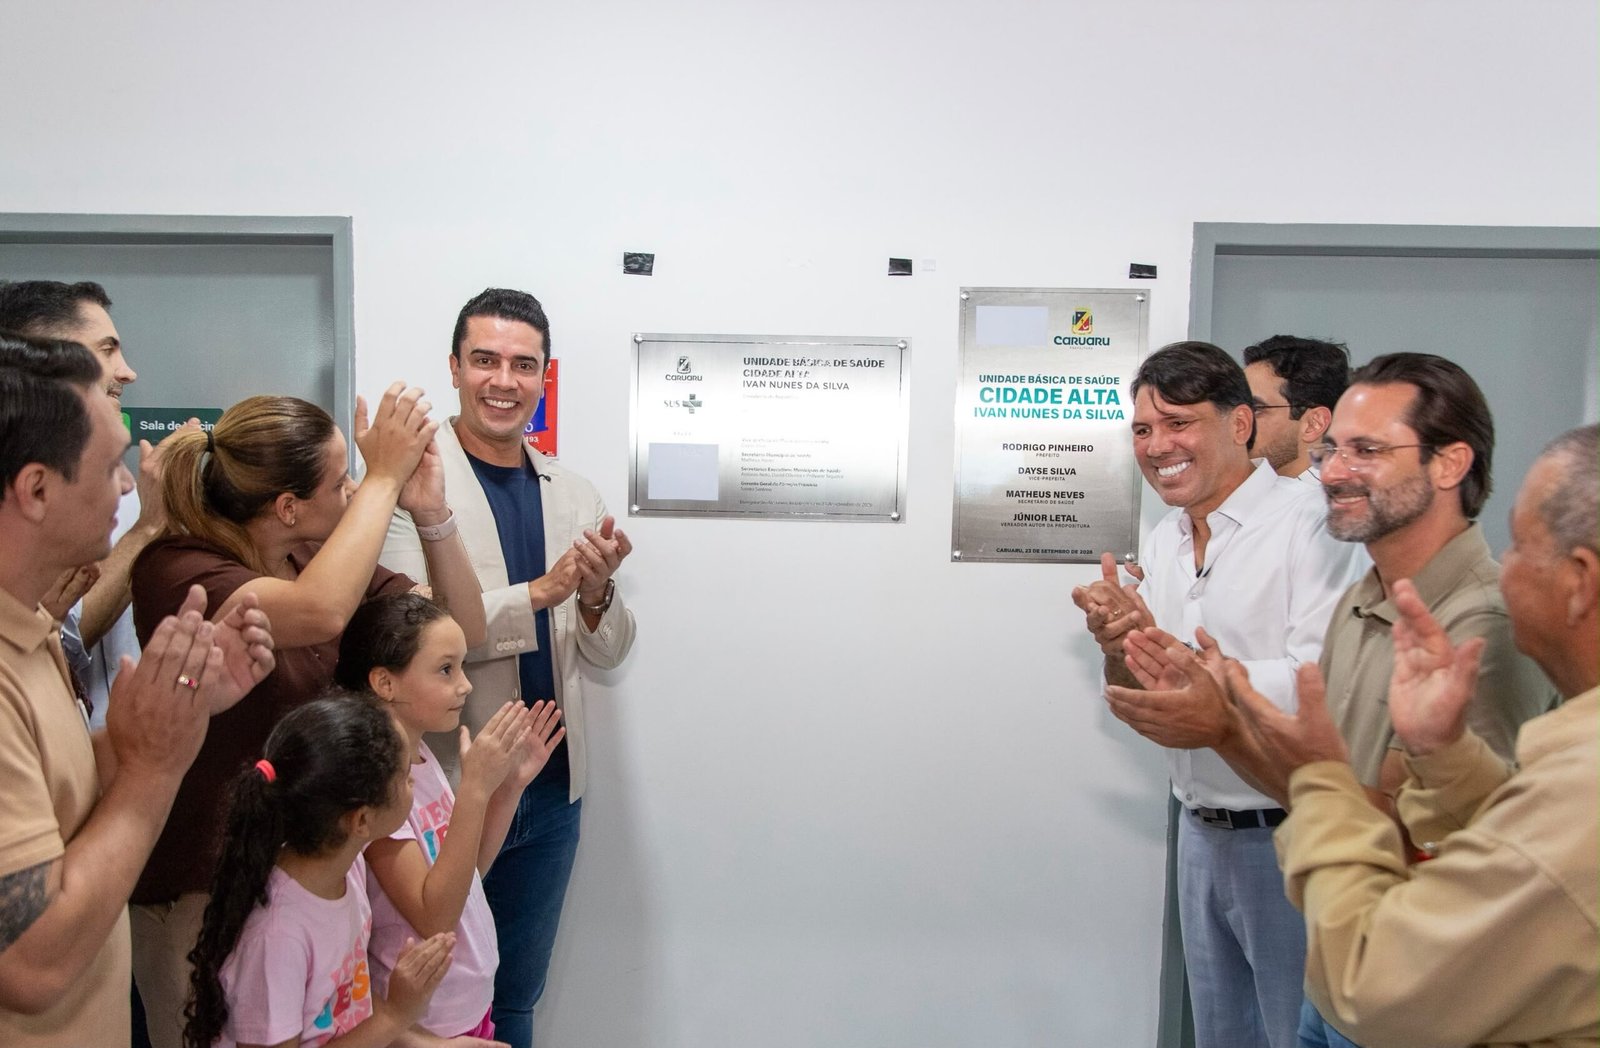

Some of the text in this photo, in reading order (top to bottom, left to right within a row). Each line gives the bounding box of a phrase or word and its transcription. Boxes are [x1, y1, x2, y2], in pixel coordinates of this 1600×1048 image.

[1054, 335, 1110, 346] CARUARU
[743, 357, 791, 367] UNIDADE
[833, 359, 848, 368] DE
[850, 357, 885, 368] SAÚDE
[665, 374, 703, 382] CARUARU
[743, 369, 783, 378] CIDADE
[979, 374, 1120, 385] UNIDADE BÁSICA DE SAÚDE
[743, 380, 850, 391] IVAN NUNES DA SILVA
[979, 386, 1121, 406] CIDADE ALTA
[974, 407, 1125, 420] IVAN NUNES DA SILVA
[140, 421, 165, 431] Sala
[167, 421, 181, 431] de
[1002, 443, 1094, 453] RODRIGO PINHEIRO
[1018, 467, 1077, 476] DAYSE SILVA
[1006, 490, 1085, 499] MATHEUS NEVES
[1013, 512, 1078, 523] JÚNIOR LETAL
